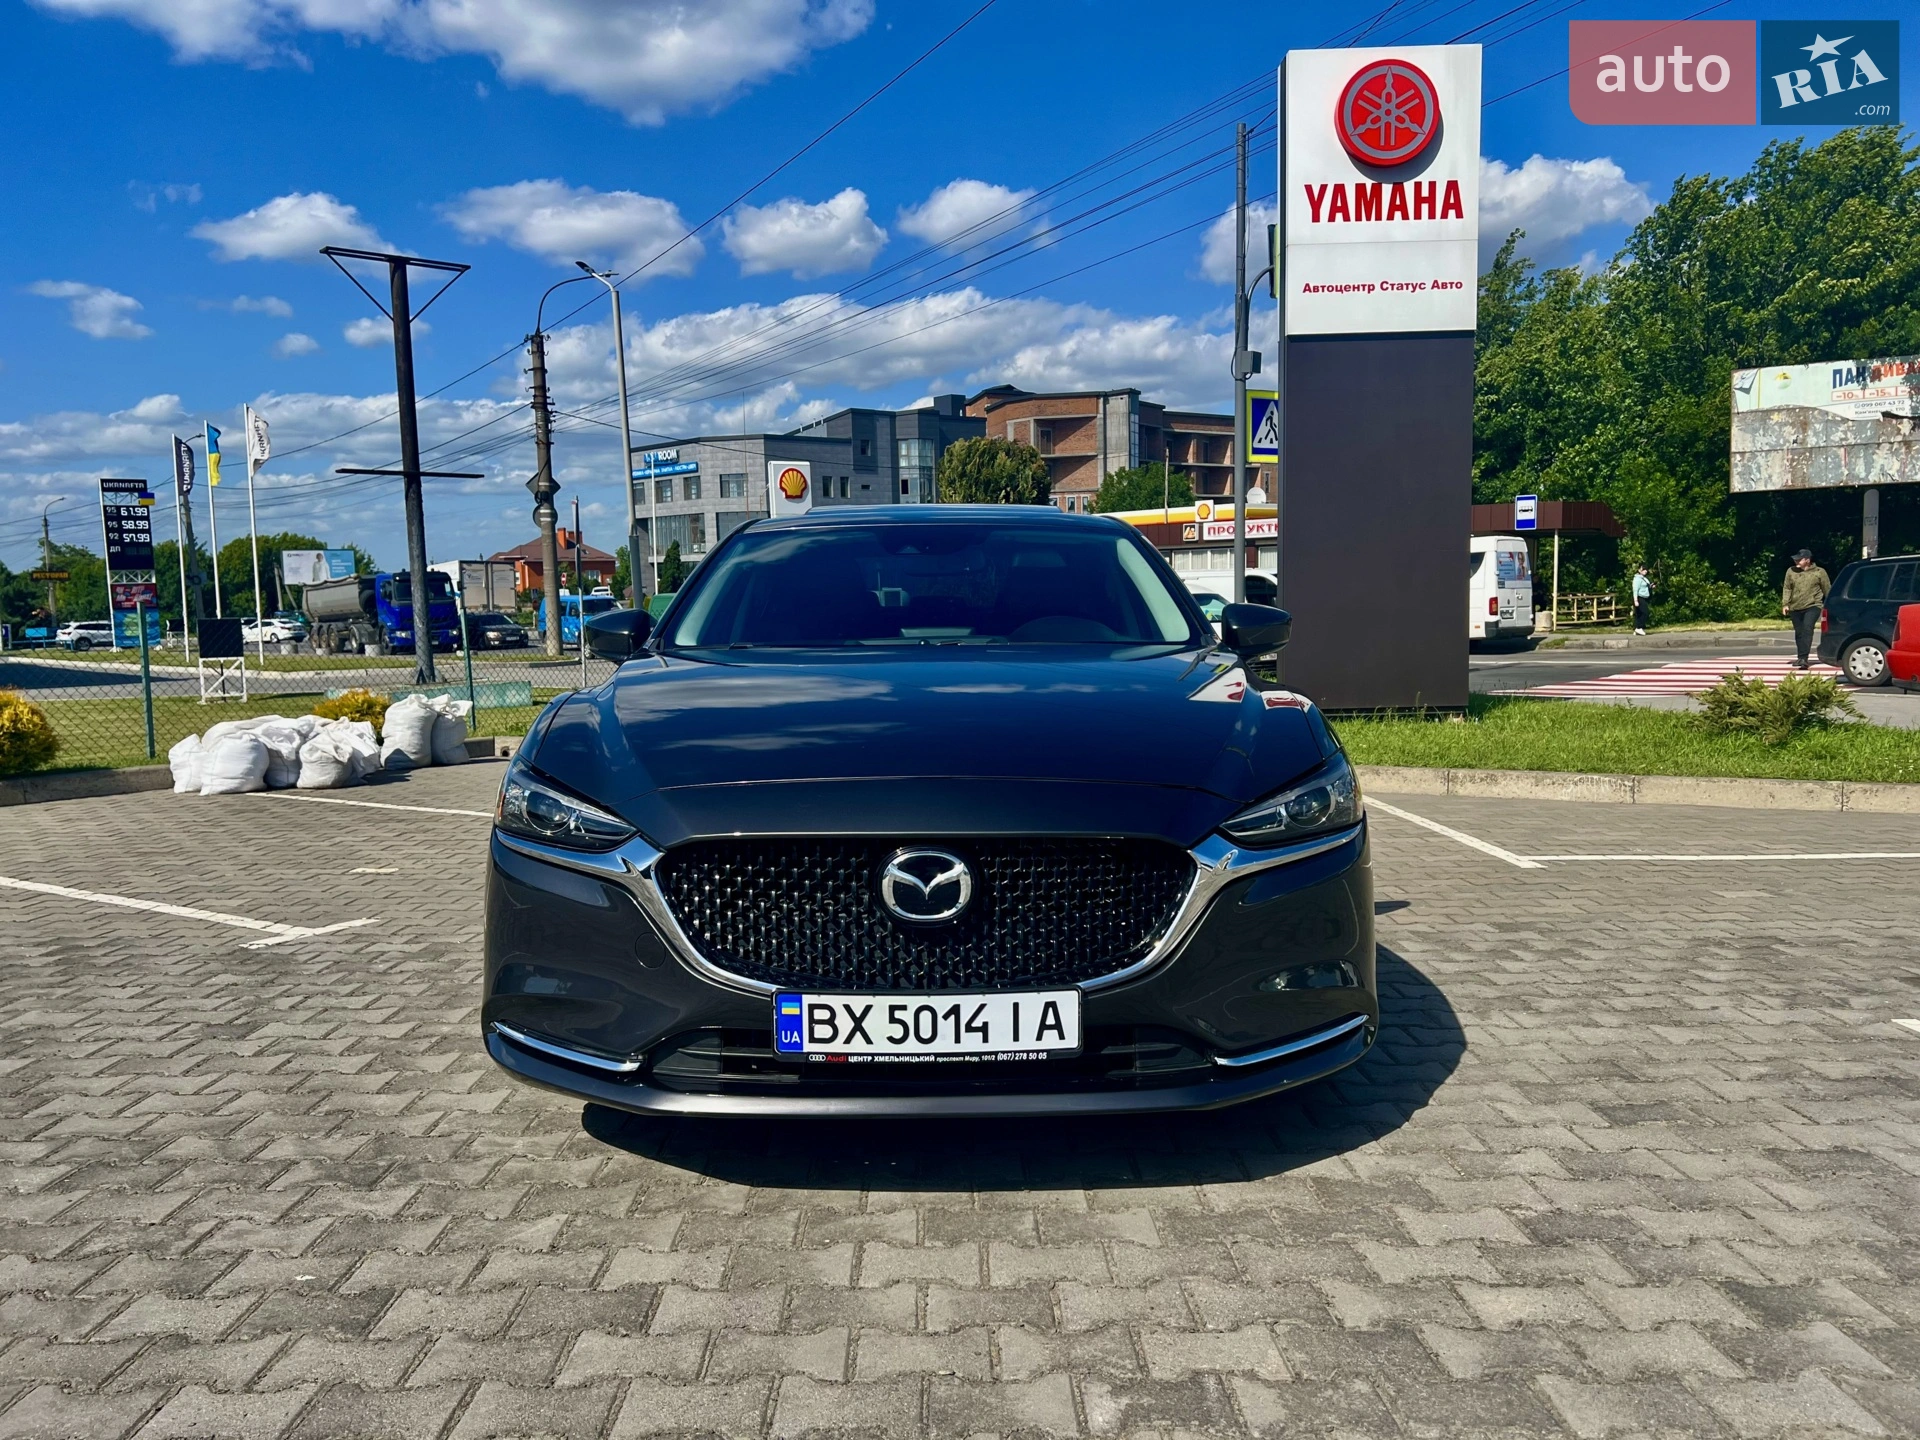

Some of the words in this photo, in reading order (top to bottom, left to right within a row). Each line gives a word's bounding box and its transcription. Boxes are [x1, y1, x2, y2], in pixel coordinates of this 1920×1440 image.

[1304, 180, 1464, 223] YAMAHA
[1302, 282, 1376, 294] Автоцентр
[1379, 280, 1427, 292] Статус
[1430, 279, 1463, 291] Авто
[1832, 366, 1867, 389] ПАН
[122, 520, 149, 530] 58.99
[1207, 523, 1278, 536] ПРОУКТ
[123, 533, 150, 543] 57.99
[807, 1003, 874, 1045] BX
[886, 1003, 989, 1045] 5014
[781, 1030, 801, 1043] UA
[873, 1054, 935, 1062] ХМЕЛЬНИЦЬКИЙ
[997, 1052, 1015, 1061] (067)
[1015, 1052, 1027, 1060] 278
[1028, 1052, 1037, 1060] 50
[1038, 1052, 1047, 1060] 05
